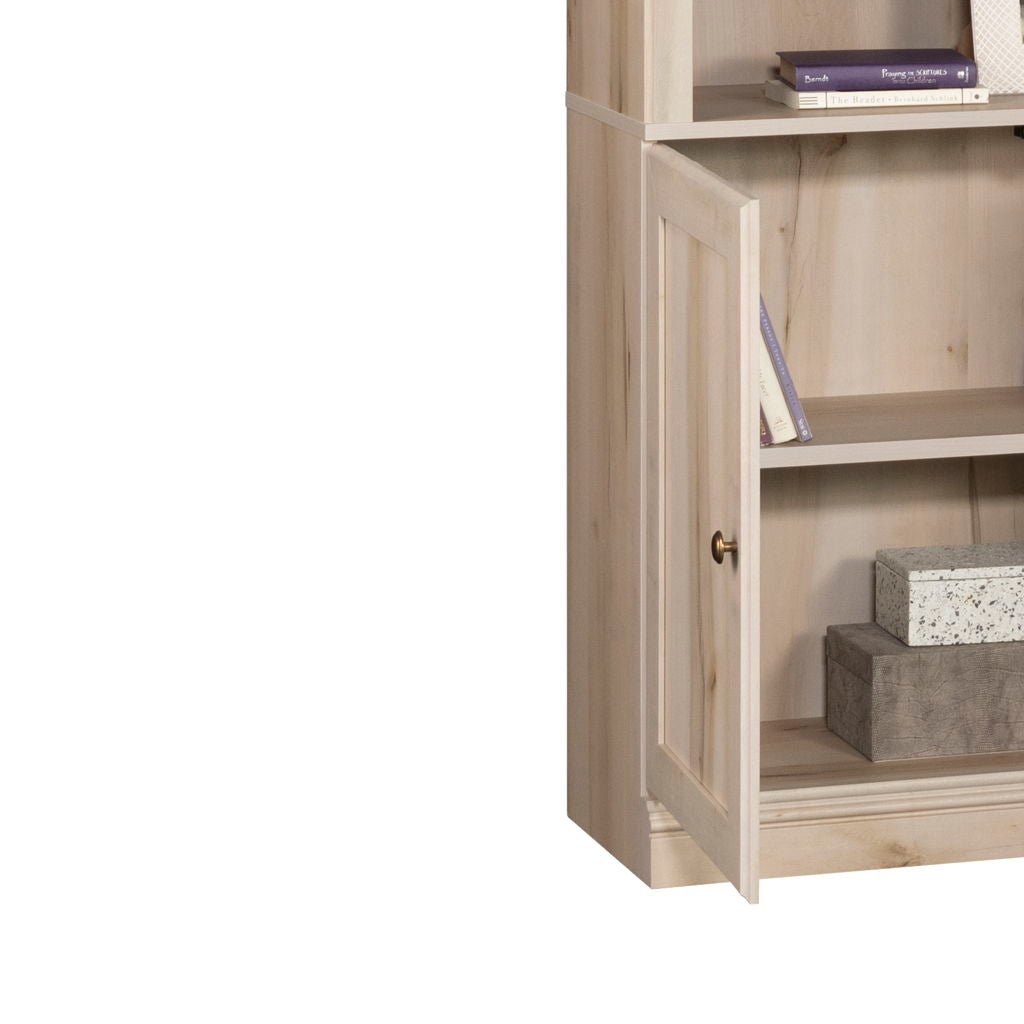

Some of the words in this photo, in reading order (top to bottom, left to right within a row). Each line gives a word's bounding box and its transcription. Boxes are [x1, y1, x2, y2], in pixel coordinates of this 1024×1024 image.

[881, 68, 907, 80] Praying
[906, 76, 937, 85] Children
[831, 96, 849, 105] The
[852, 95, 885, 104] Reader
